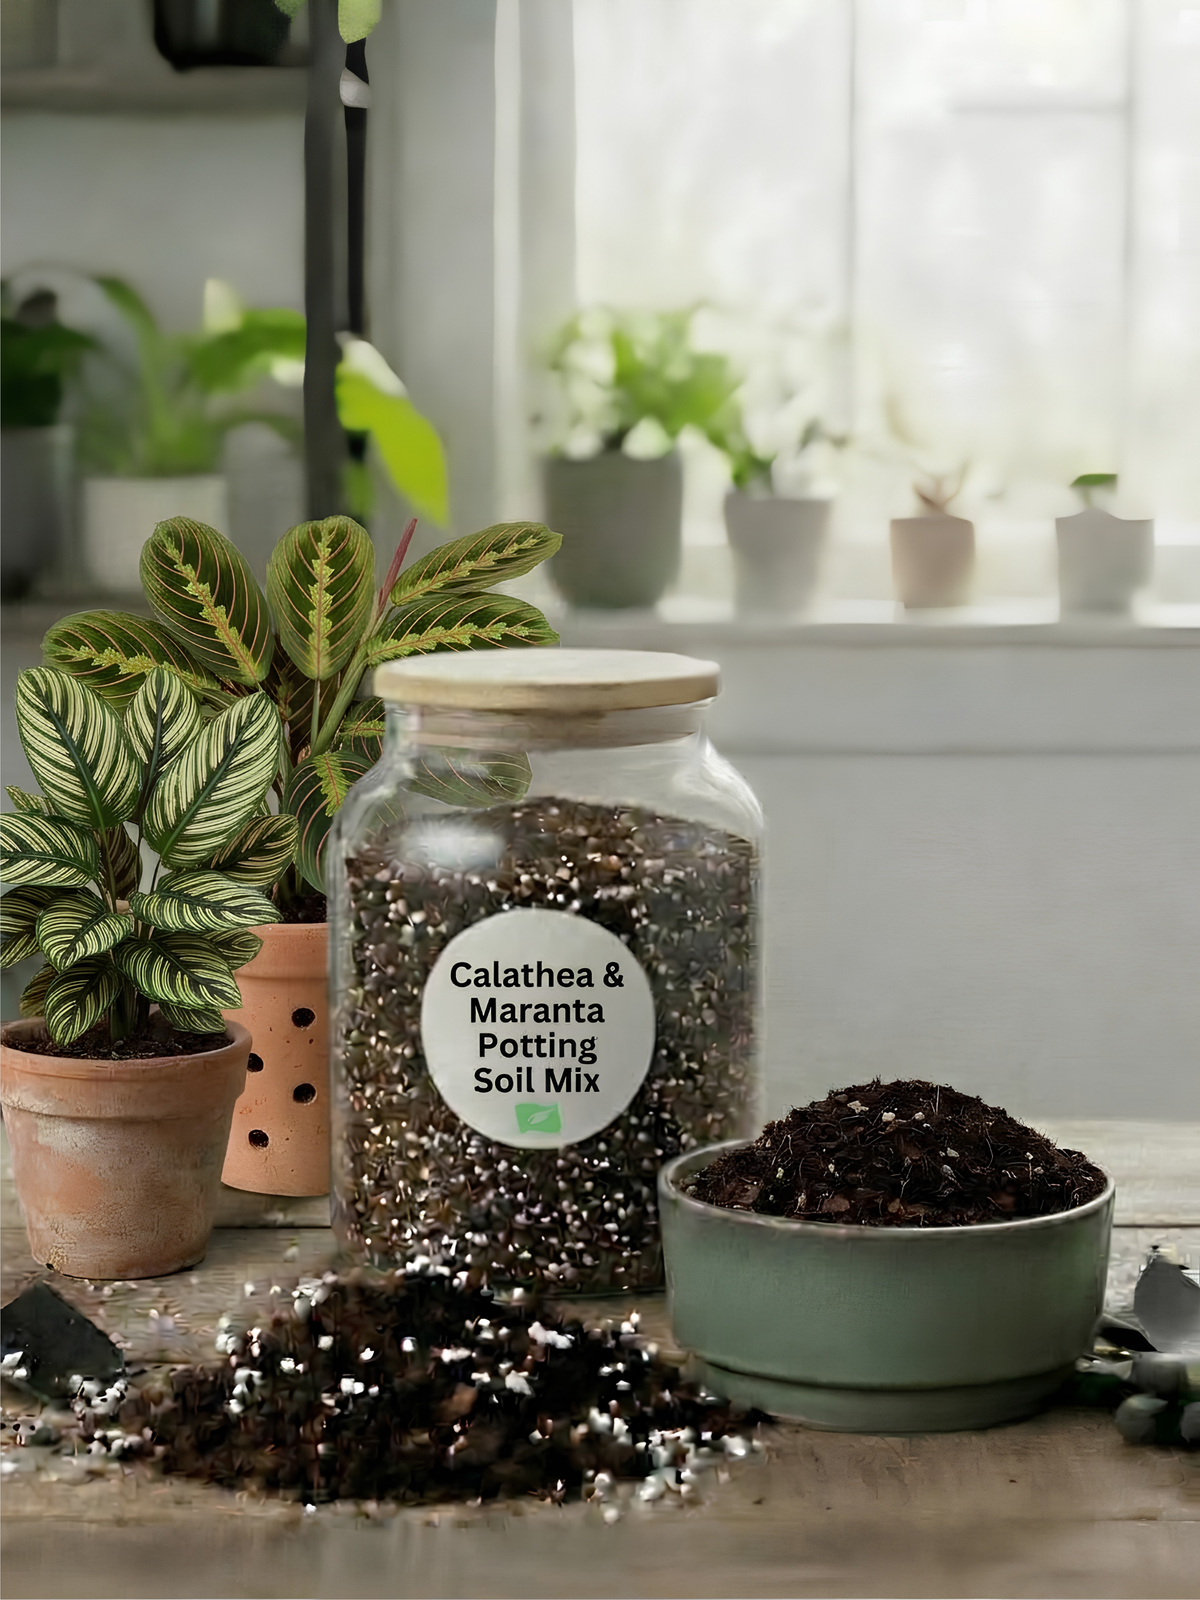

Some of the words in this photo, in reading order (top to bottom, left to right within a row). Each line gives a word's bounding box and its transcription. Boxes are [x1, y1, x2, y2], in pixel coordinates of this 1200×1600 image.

[450, 961, 595, 988] Calathea
[602, 961, 625, 988] &
[470, 997, 606, 1024] Maranta
[479, 1031, 599, 1065] Potting
[474, 1066, 536, 1093] Soil
[544, 1066, 601, 1093] Mix
